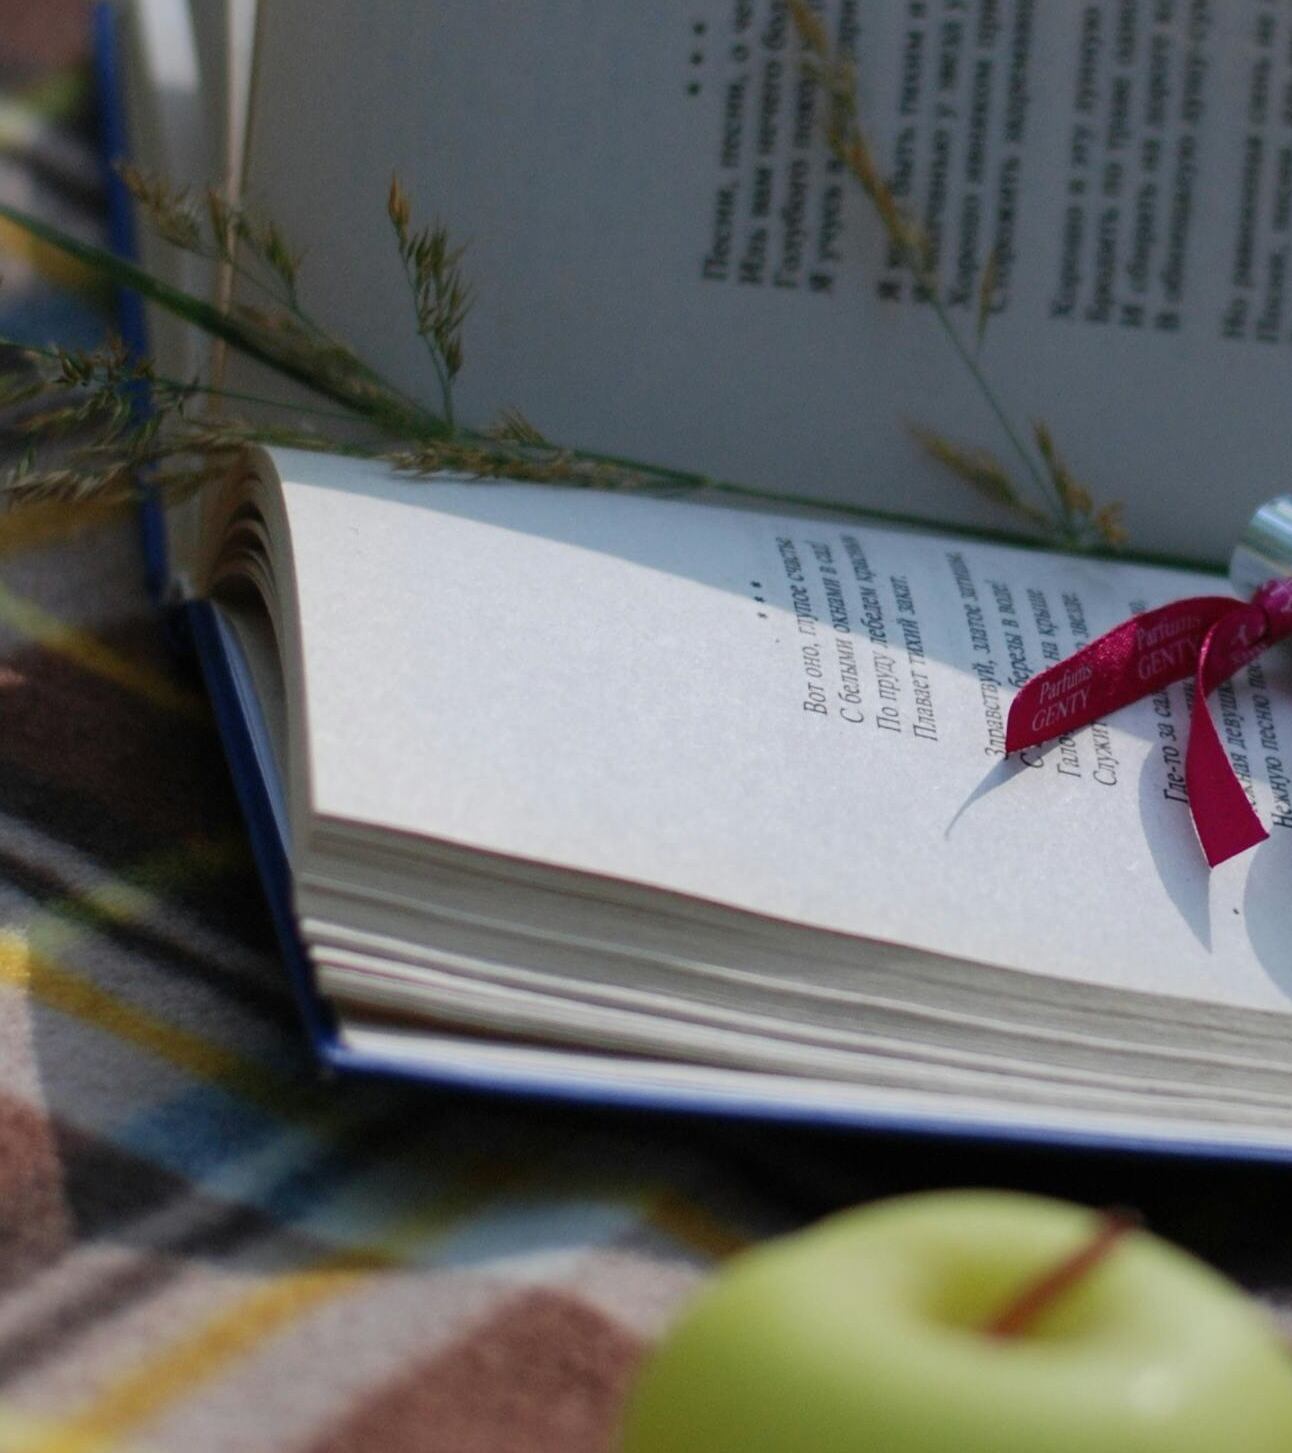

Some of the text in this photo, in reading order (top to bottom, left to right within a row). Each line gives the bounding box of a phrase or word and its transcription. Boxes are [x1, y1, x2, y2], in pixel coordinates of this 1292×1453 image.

[789, 585, 818, 635] глупое
[818, 577, 850, 634] окнами
[859, 587, 887, 648] лебедем
[963, 603, 990, 655] златое
[1026, 588, 1058, 637] крыше
[802, 643, 822, 678] оно,
[835, 638, 861, 704] белыми
[871, 651, 900, 701] пруду
[889, 575, 938, 741] Плавает тихий закат.
[1006, 634, 1033, 688] березы
[803, 683, 827, 715] Вот
[973, 660, 1007, 758] Здравствуй,
[1031, 686, 1092, 732] GENTY
[1039, 663, 1093, 705] Parfums
[840, 708, 864, 723] С
[876, 707, 901, 733] По
[1156, 722, 1176, 742] за
[1217, 677, 1247, 750] девушк
[1251, 695, 1280, 752] песню
[1056, 732, 1082, 779] Гало
[1162, 746, 1189, 804] Где-то
